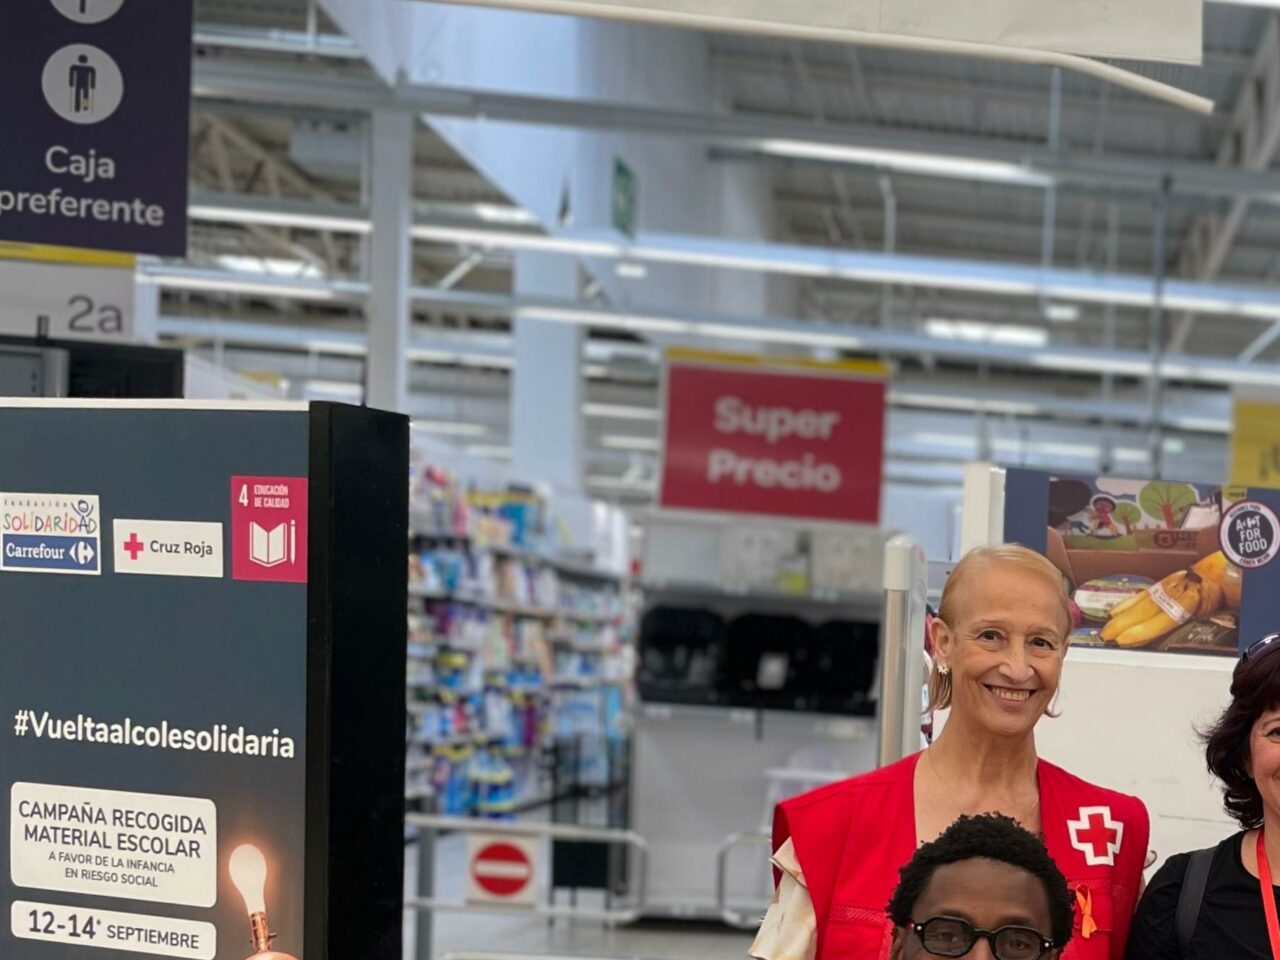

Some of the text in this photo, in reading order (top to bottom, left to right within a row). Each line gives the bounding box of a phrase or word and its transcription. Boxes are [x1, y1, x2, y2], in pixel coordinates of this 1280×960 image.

[45, 146, 116, 182] Caja
[0, 188, 164, 227] preferente
[67, 295, 124, 333] 2a
[713, 395, 841, 443] Super
[706, 447, 841, 492] Precio
[238, 483, 249, 507] 4
[150, 540, 213, 558] Cruz Roja
[1238, 538, 1268, 555] FOOD
[1239, 527, 1262, 542] FOR
[6, 542, 65, 560] Carrefour
[14, 709, 295, 759] #Vueltaalcolesolidaria
[18, 800, 207, 835] CAMPAÑA RECOGIDA
[23, 823, 201, 859] MATERIAL ESCOLAR
[48, 851, 175, 874] A FAVOR DE LA INFANCIA
[64, 867, 159, 888] EN RIESGO SOCIAL
[106, 924, 200, 950] SEPTIEMBRE
